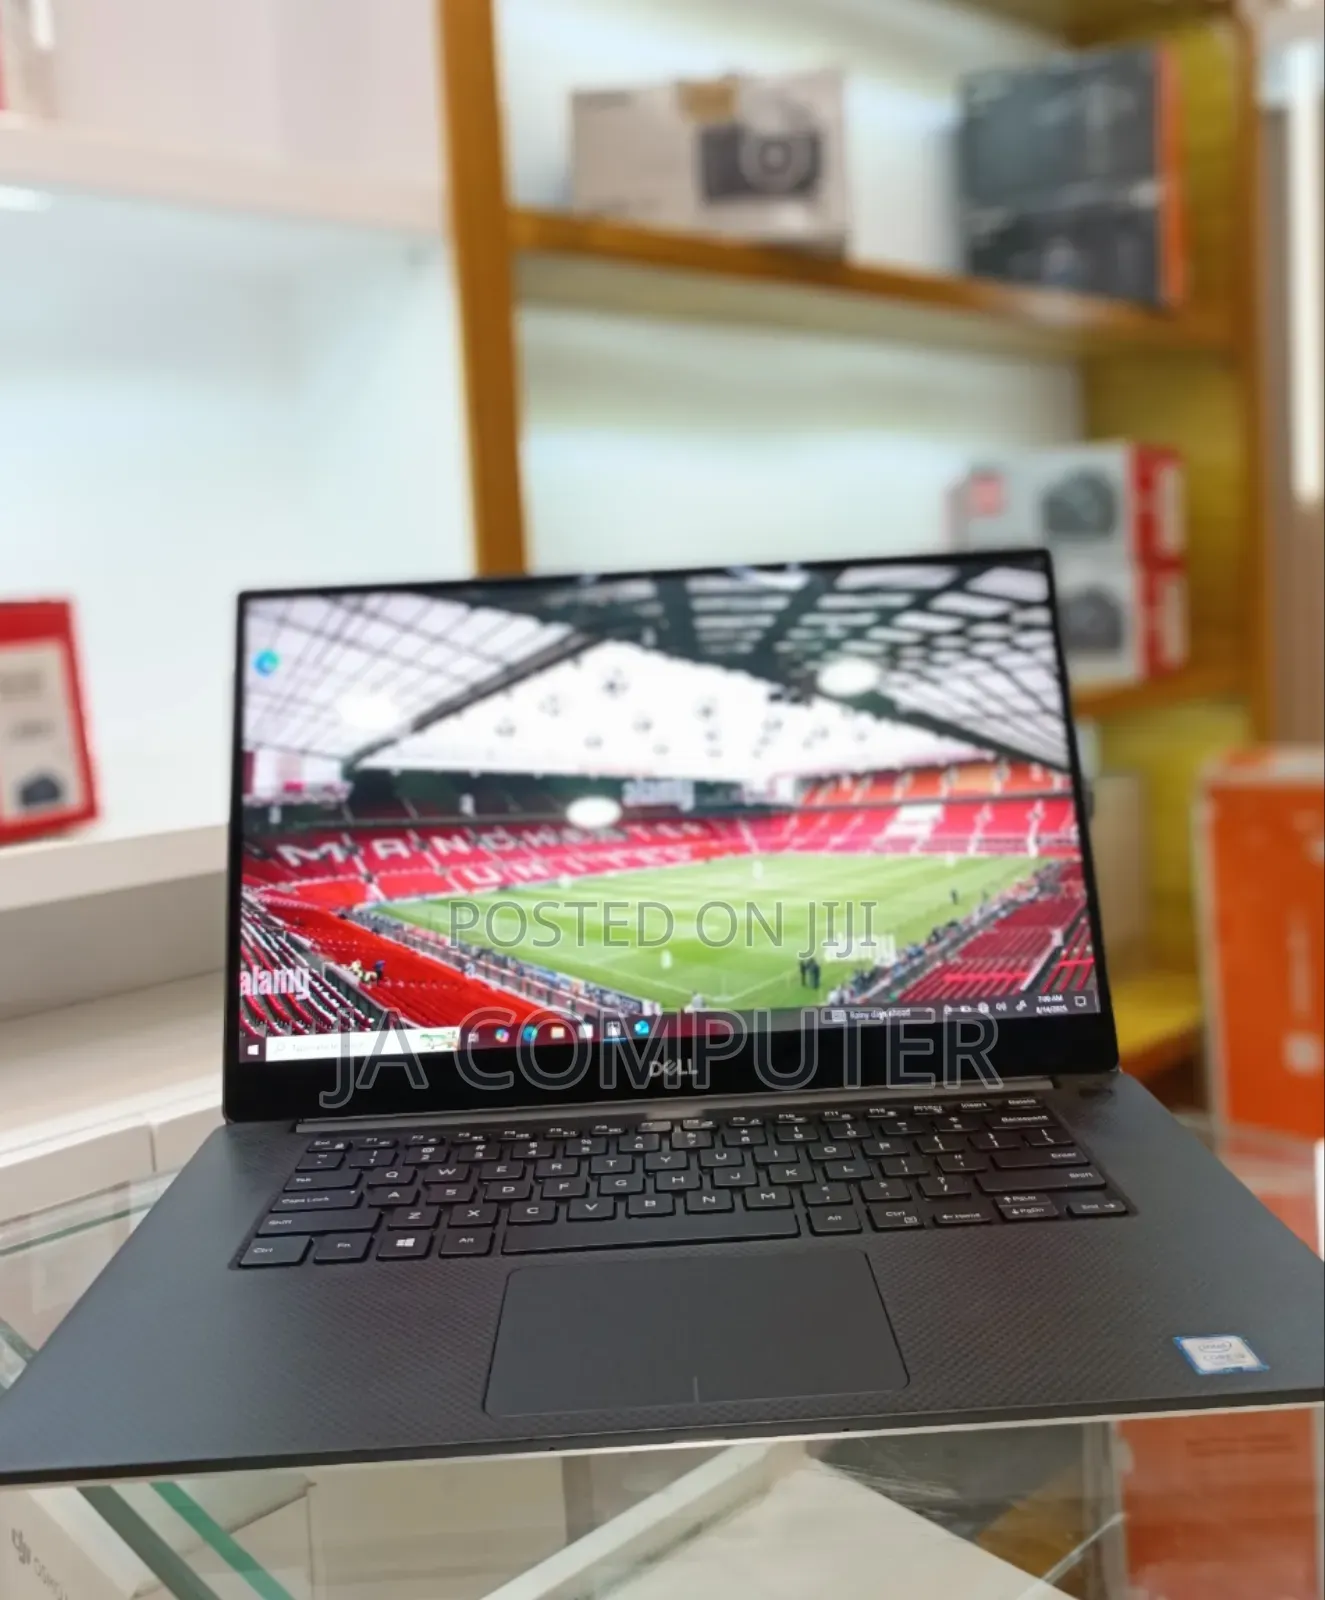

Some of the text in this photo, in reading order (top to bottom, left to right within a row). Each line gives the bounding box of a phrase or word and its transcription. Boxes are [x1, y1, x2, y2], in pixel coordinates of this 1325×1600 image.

[240, 965, 310, 1001] alamy
[649, 1058, 698, 1077] DELL
[606, 1159, 617, 1167] T
[438, 1168, 457, 1176] W
[496, 1165, 508, 1173] E
[671, 1176, 685, 1184] H
[730, 1172, 741, 1180] J
[558, 1182, 570, 1190] F
[614, 1179, 628, 1187] G
[702, 1195, 717, 1204] N
[760, 1192, 776, 1200] M
[585, 1203, 599, 1211] V
[467, 1209, 481, 1217] X
